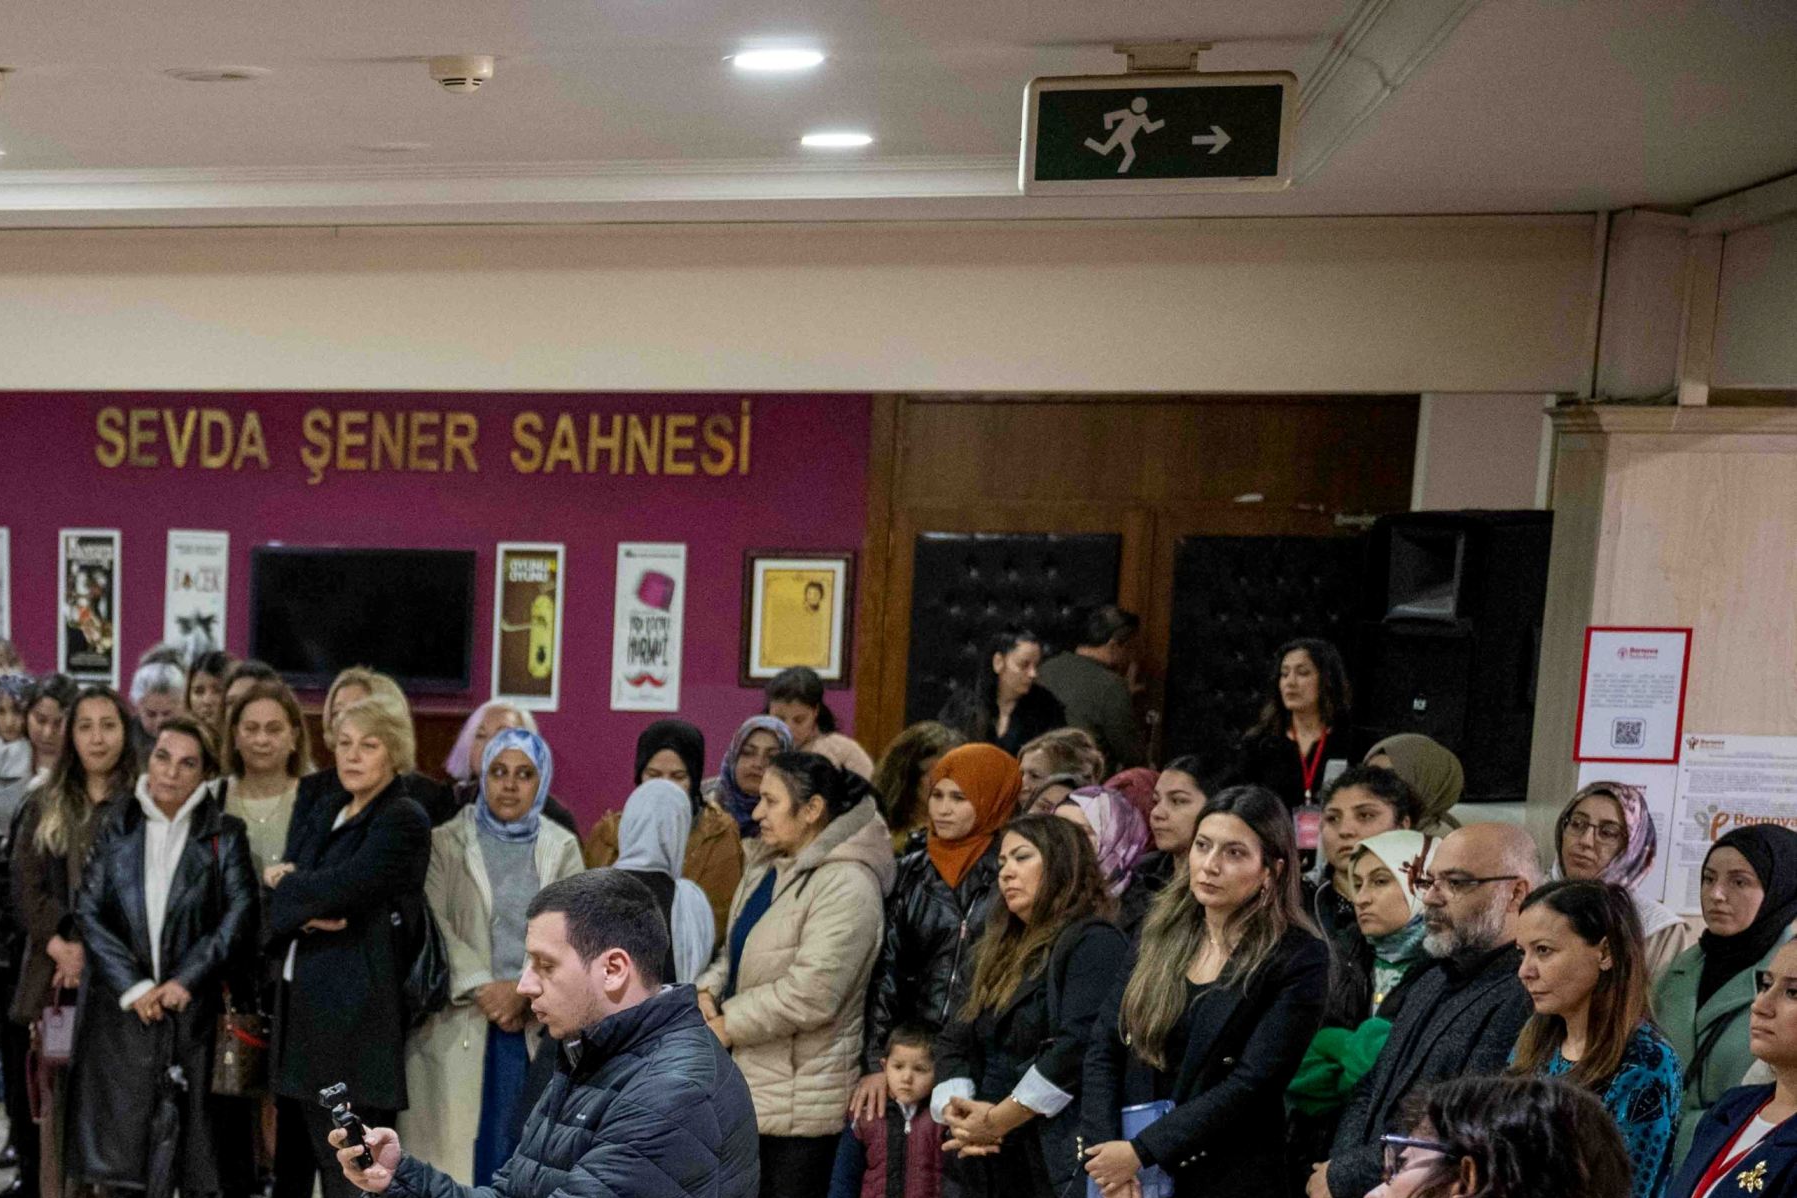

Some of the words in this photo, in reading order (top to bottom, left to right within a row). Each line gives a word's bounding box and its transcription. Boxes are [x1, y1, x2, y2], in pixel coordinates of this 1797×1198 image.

[95, 406, 269, 470] SEVDA
[300, 407, 480, 485] ŞENER
[510, 400, 752, 477] SAHNESİ
